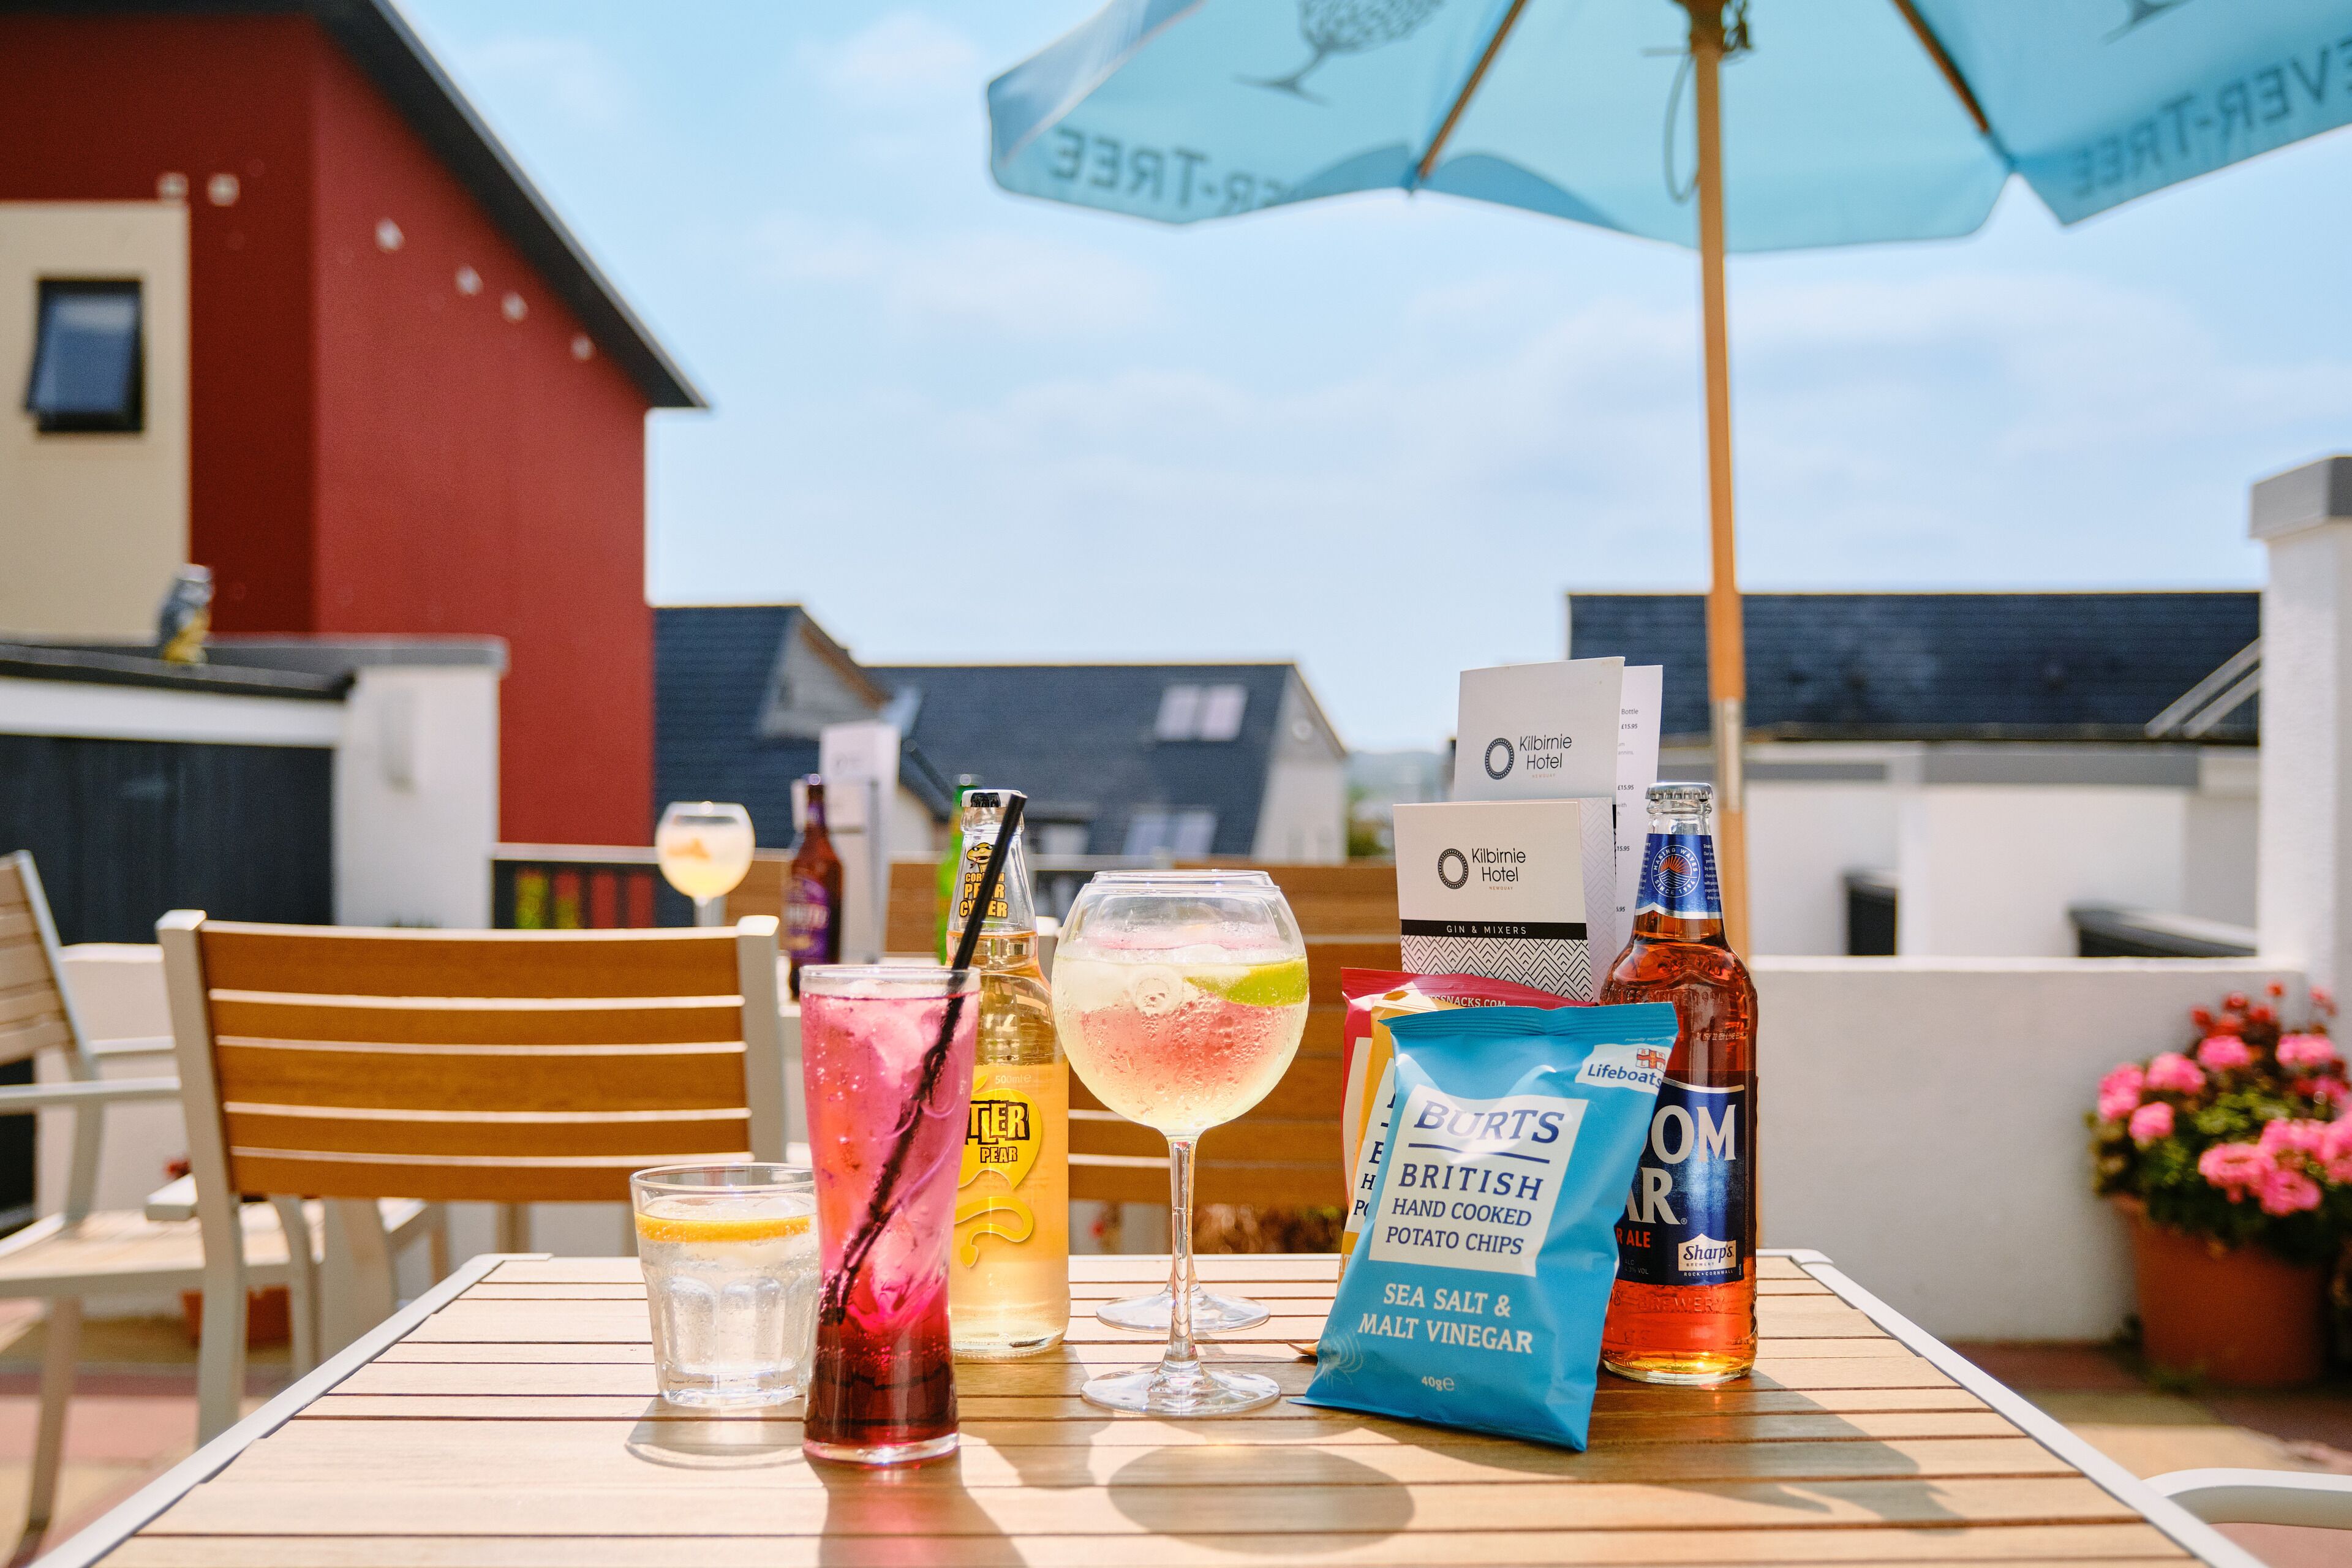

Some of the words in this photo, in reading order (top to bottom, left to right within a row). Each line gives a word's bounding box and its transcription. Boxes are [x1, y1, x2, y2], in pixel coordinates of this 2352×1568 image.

[1520, 733, 1572, 752] Kilbirnie
[1527, 753, 1562, 770] Hotel
[1472, 848, 1526, 863] Kilbirnie
[1654, 848, 1676, 870] MAKING
[1680, 848, 1698, 872] WAVES
[965, 872, 1005, 883] CORH
[1482, 867, 1518, 881] Hotel
[1655, 880, 1674, 895] SINCE
[1679, 880, 1695, 894] 1994
[959, 900, 1008, 918] CYER
[1446, 925, 1465, 933] GIN
[1484, 925, 1526, 935] MIXERS
[1414, 1100, 1565, 1144] BURTS
[980, 1147, 1017, 1163] PEAR
[1398, 1163, 1544, 1201] BRITISH
[1392, 1197, 1446, 1218] HAND
[1452, 1202, 1532, 1227] COOKED
[1385, 1226, 1459, 1249] POTATO
[1465, 1233, 1524, 1255] CHIPS
[1626, 1229, 1651, 1248] ALE
[1683, 1245, 1733, 1263] Sharp's
[1383, 1283, 1425, 1308] SEA
[1434, 1288, 1488, 1314] SALT
[1494, 1295, 1511, 1317] &
[1357, 1313, 1419, 1339] MALT
[1427, 1320, 1533, 1354] VINEGAR
